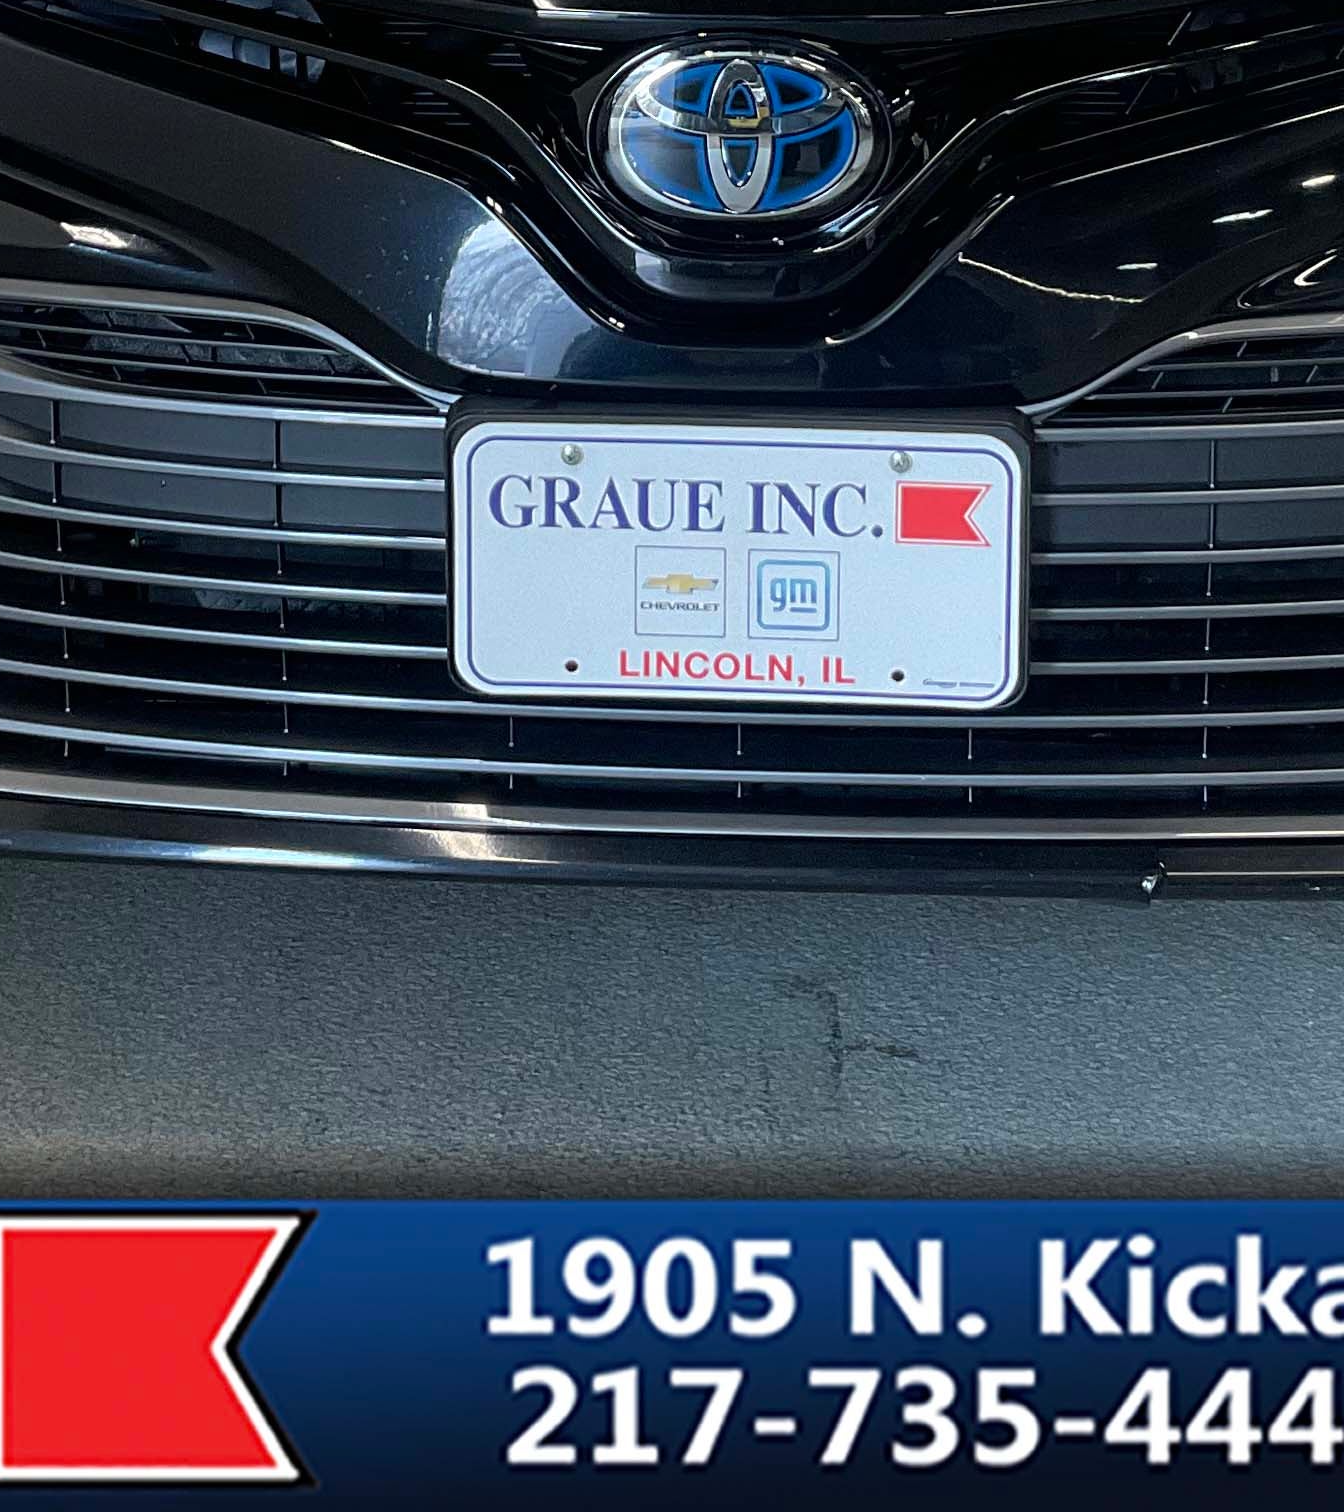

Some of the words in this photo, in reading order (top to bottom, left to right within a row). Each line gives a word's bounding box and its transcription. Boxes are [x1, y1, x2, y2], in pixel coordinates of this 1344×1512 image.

[488, 474, 724, 533] GRAUE
[747, 480, 884, 539] INC.
[640, 600, 720, 612] CHEVROLET
[618, 650, 806, 686] LINCOLN,
[822, 656, 855, 685] IL
